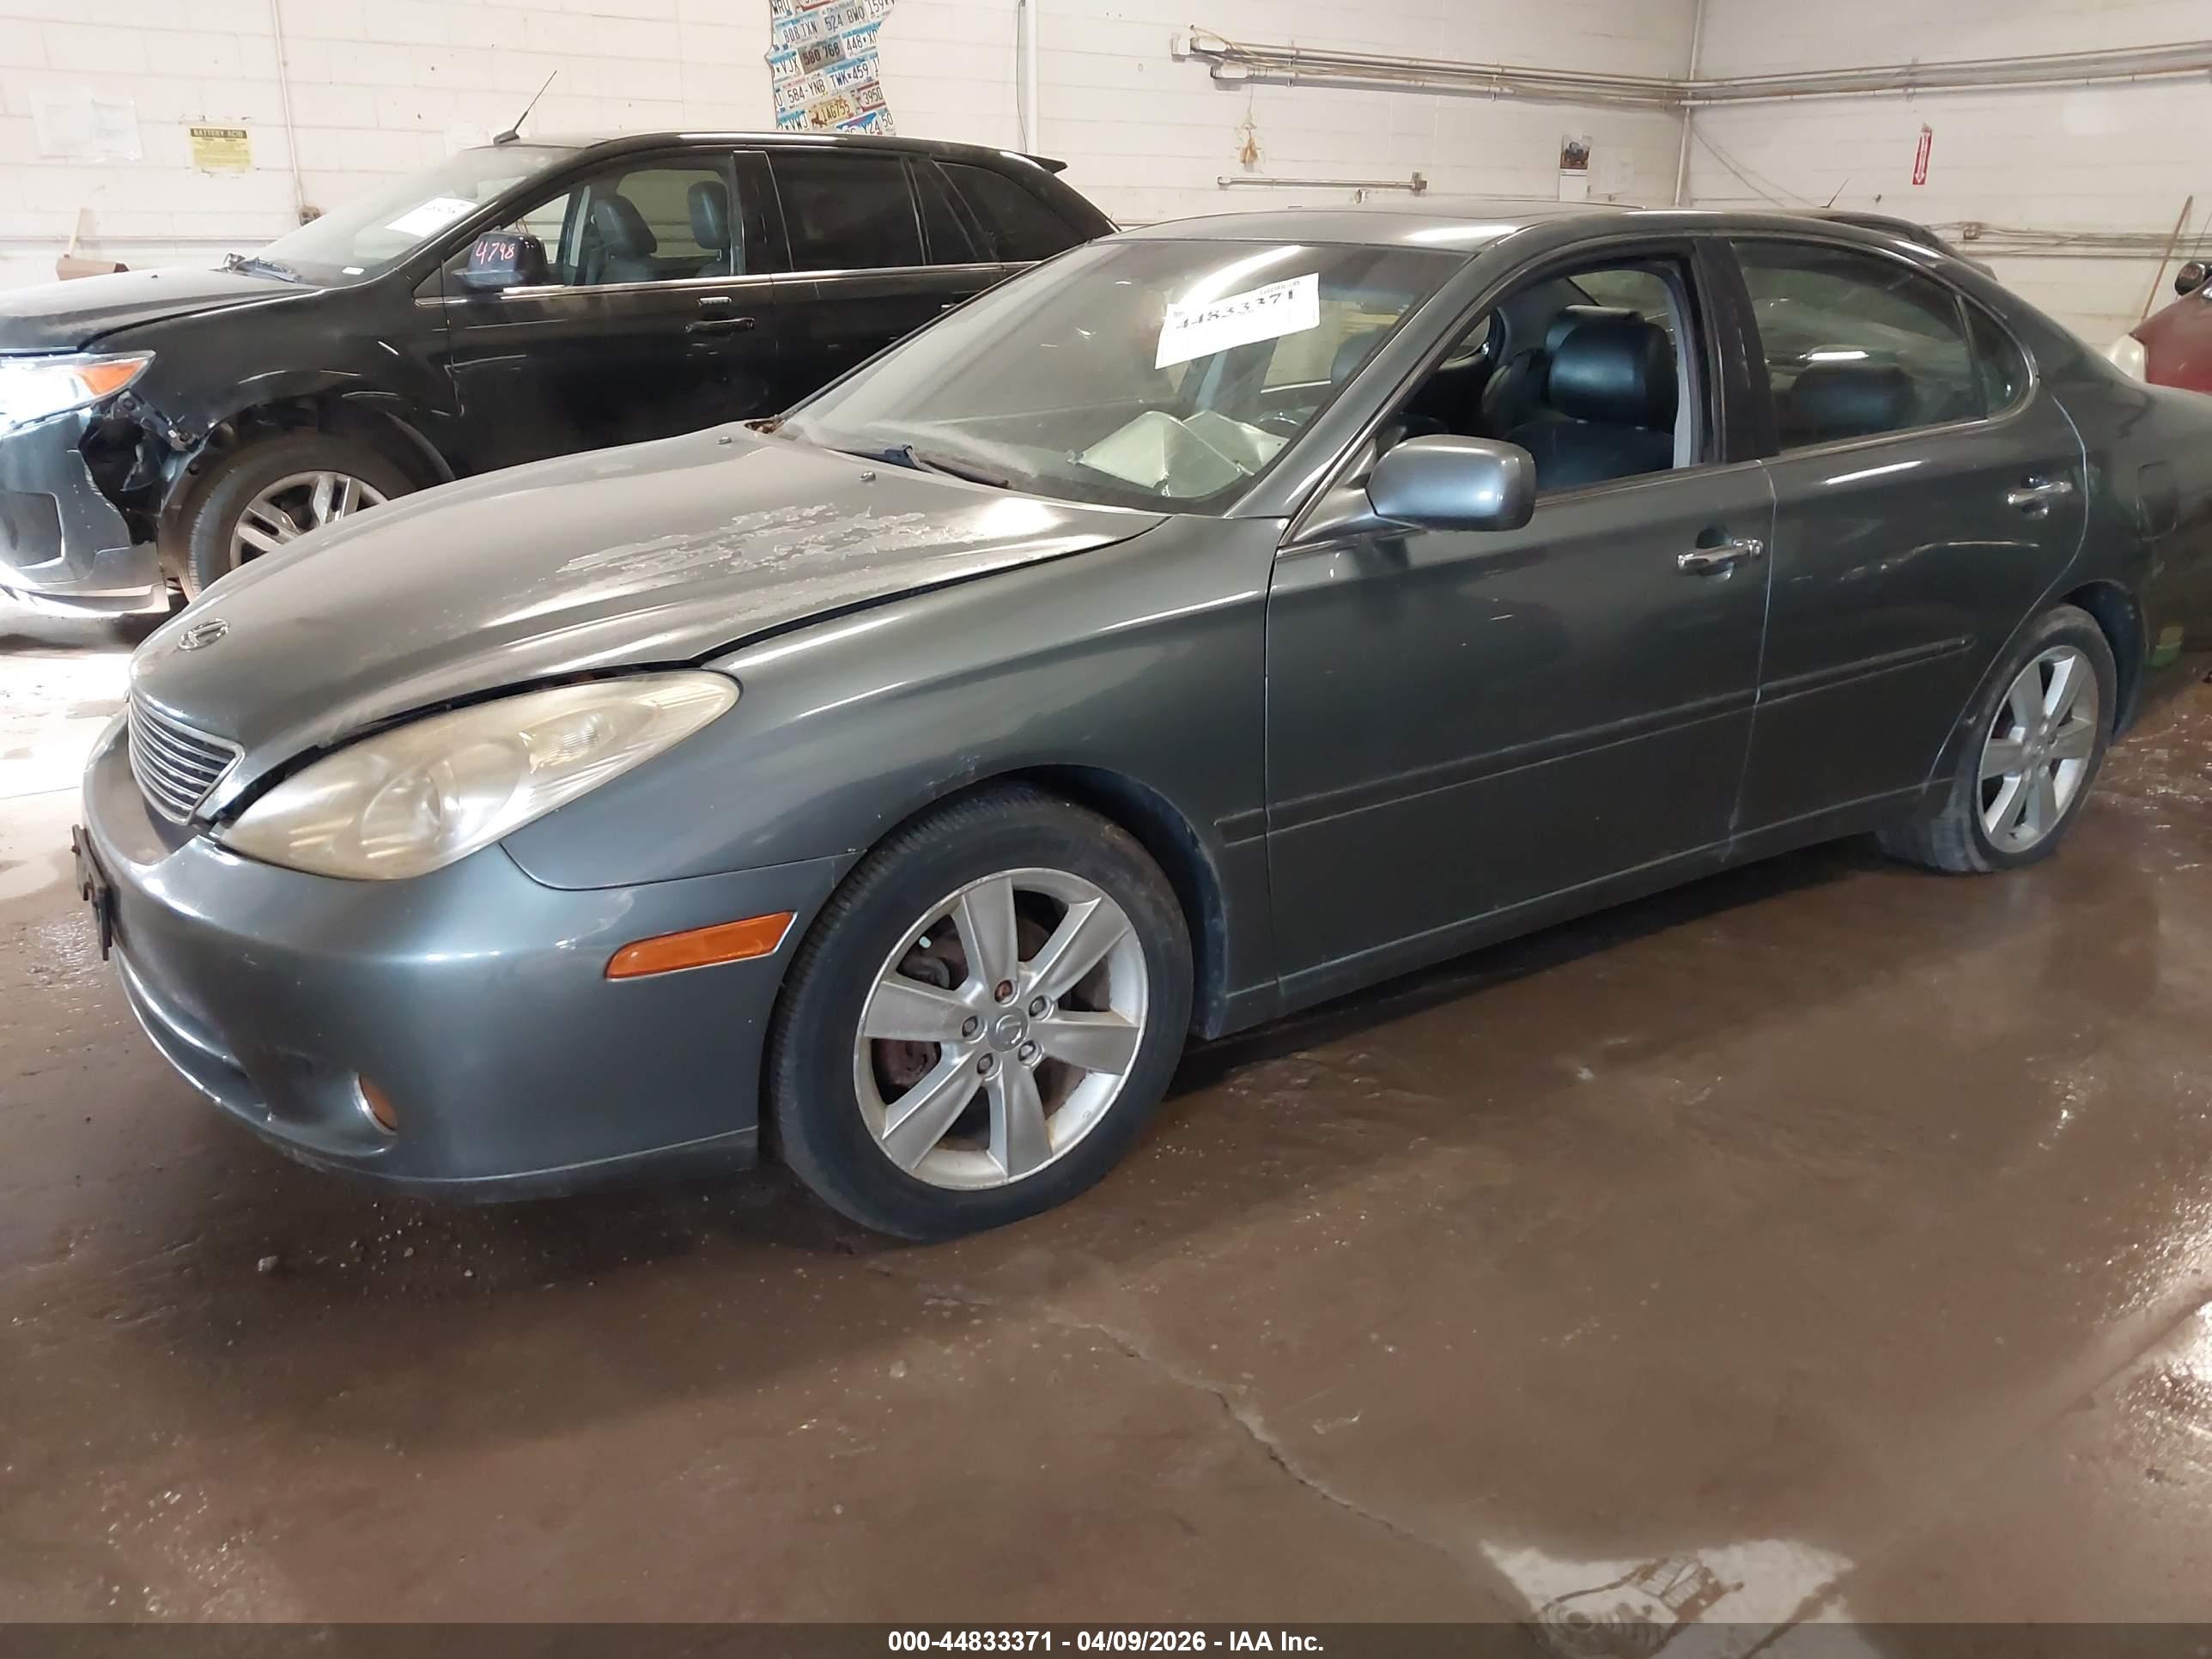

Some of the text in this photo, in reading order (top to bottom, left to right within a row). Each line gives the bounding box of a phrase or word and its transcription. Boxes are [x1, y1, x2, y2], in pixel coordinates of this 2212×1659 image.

[800, 21, 818, 37] TXN
[823, 13, 843, 33] 524
[847, 34, 863, 51] 448
[853, 63, 869, 81] 459
[193, 128, 224, 137] BATTERY
[475, 240, 516, 265] 4798
